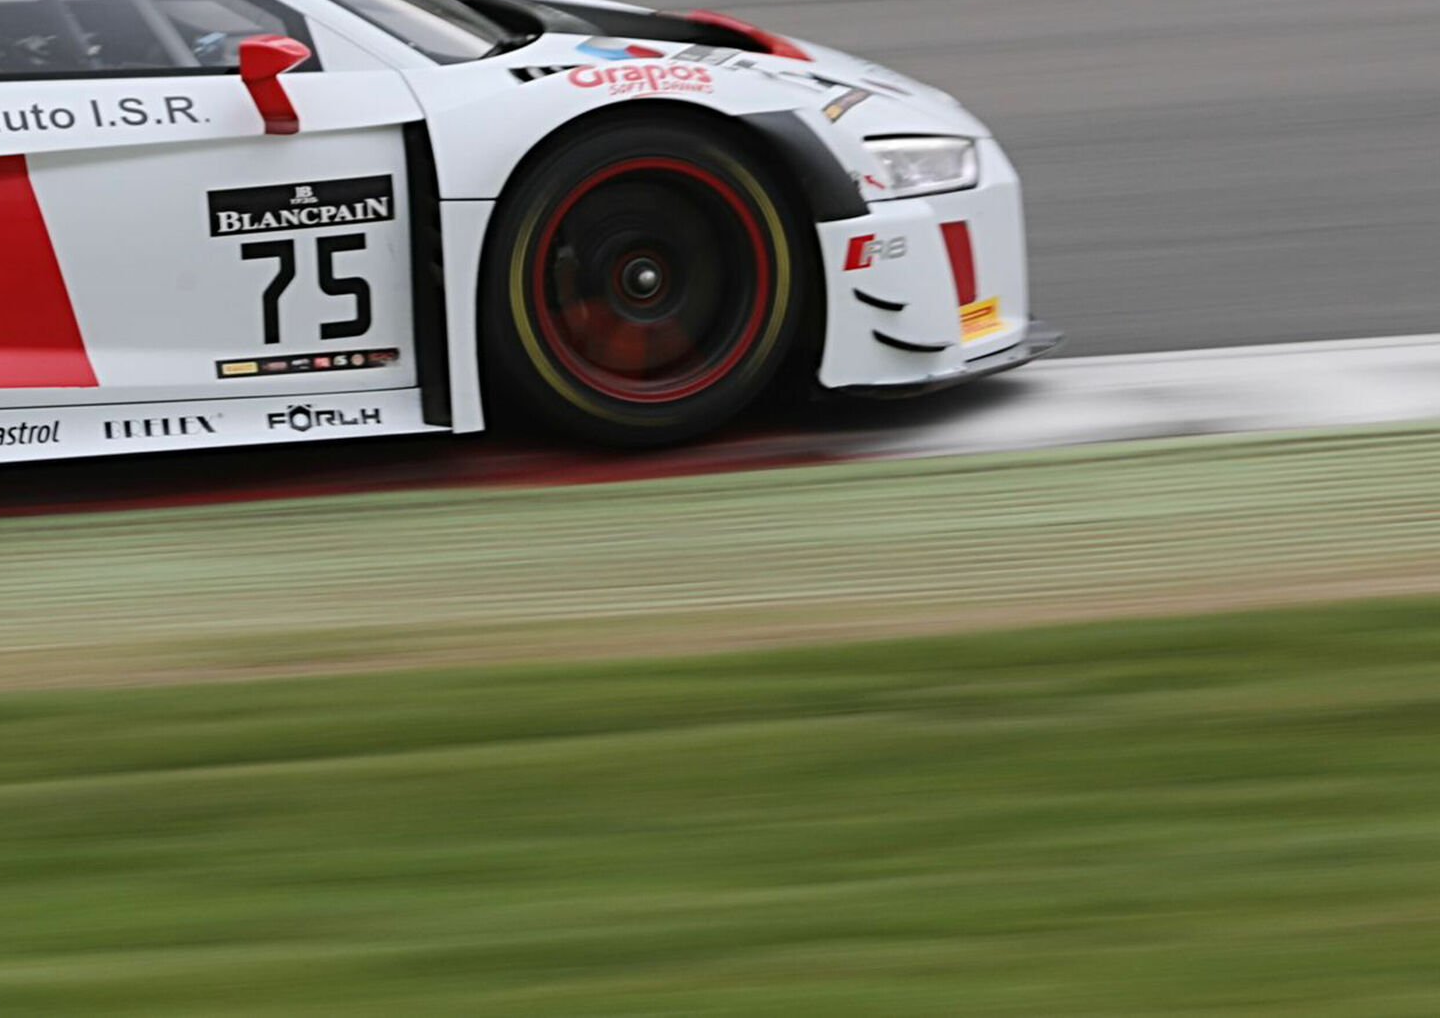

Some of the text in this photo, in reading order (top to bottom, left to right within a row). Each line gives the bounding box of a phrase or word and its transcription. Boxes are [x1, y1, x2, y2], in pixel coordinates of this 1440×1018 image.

[567, 64, 714, 90] Grapos
[90, 96, 211, 127] I.S.R.
[860, 236, 906, 263] R8
[241, 233, 372, 344] 75
